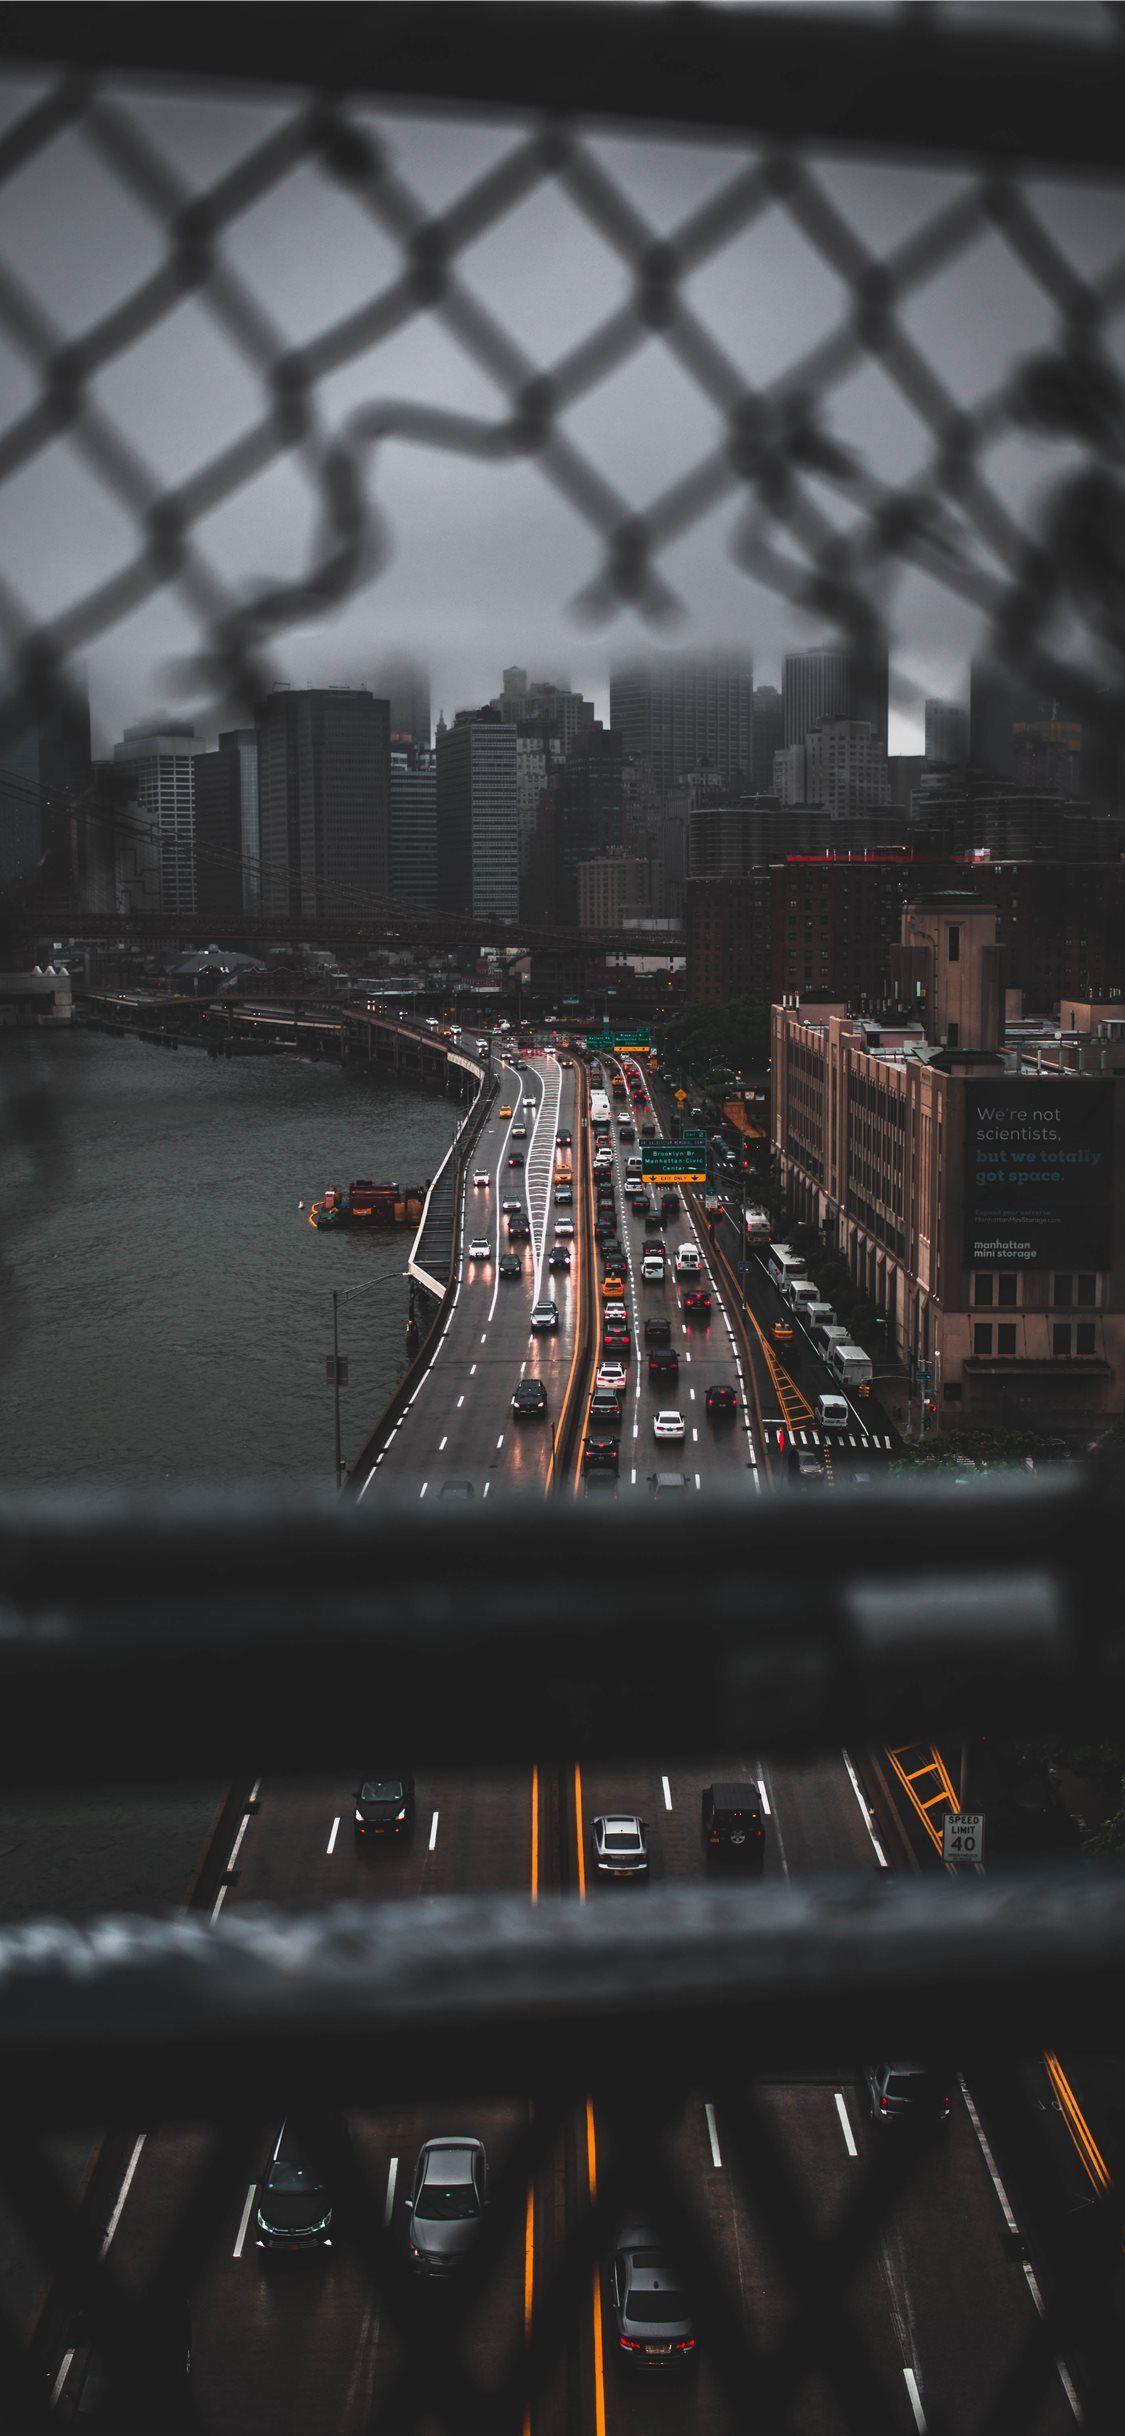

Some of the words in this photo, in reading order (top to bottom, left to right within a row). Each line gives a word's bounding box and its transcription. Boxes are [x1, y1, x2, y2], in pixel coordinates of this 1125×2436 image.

[977, 1107, 1027, 1121] We're
[1033, 1108, 1061, 1121] not
[977, 1127, 1062, 1141] scientists,
[976, 1150, 1007, 1163] but
[1011, 1152, 1036, 1163] we
[1040, 1150, 1102, 1166] totally
[975, 1169, 1005, 1185] got
[1008, 1171, 1065, 1184] space.
[974, 1238, 1031, 1249] manhattan
[974, 1249, 995, 1257] mini
[997, 1249, 1037, 1260] storage
[948, 1816, 979, 1824] SPEED
[951, 1826, 976, 1834] LIMIT
[950, 1836, 976, 1851] 40
